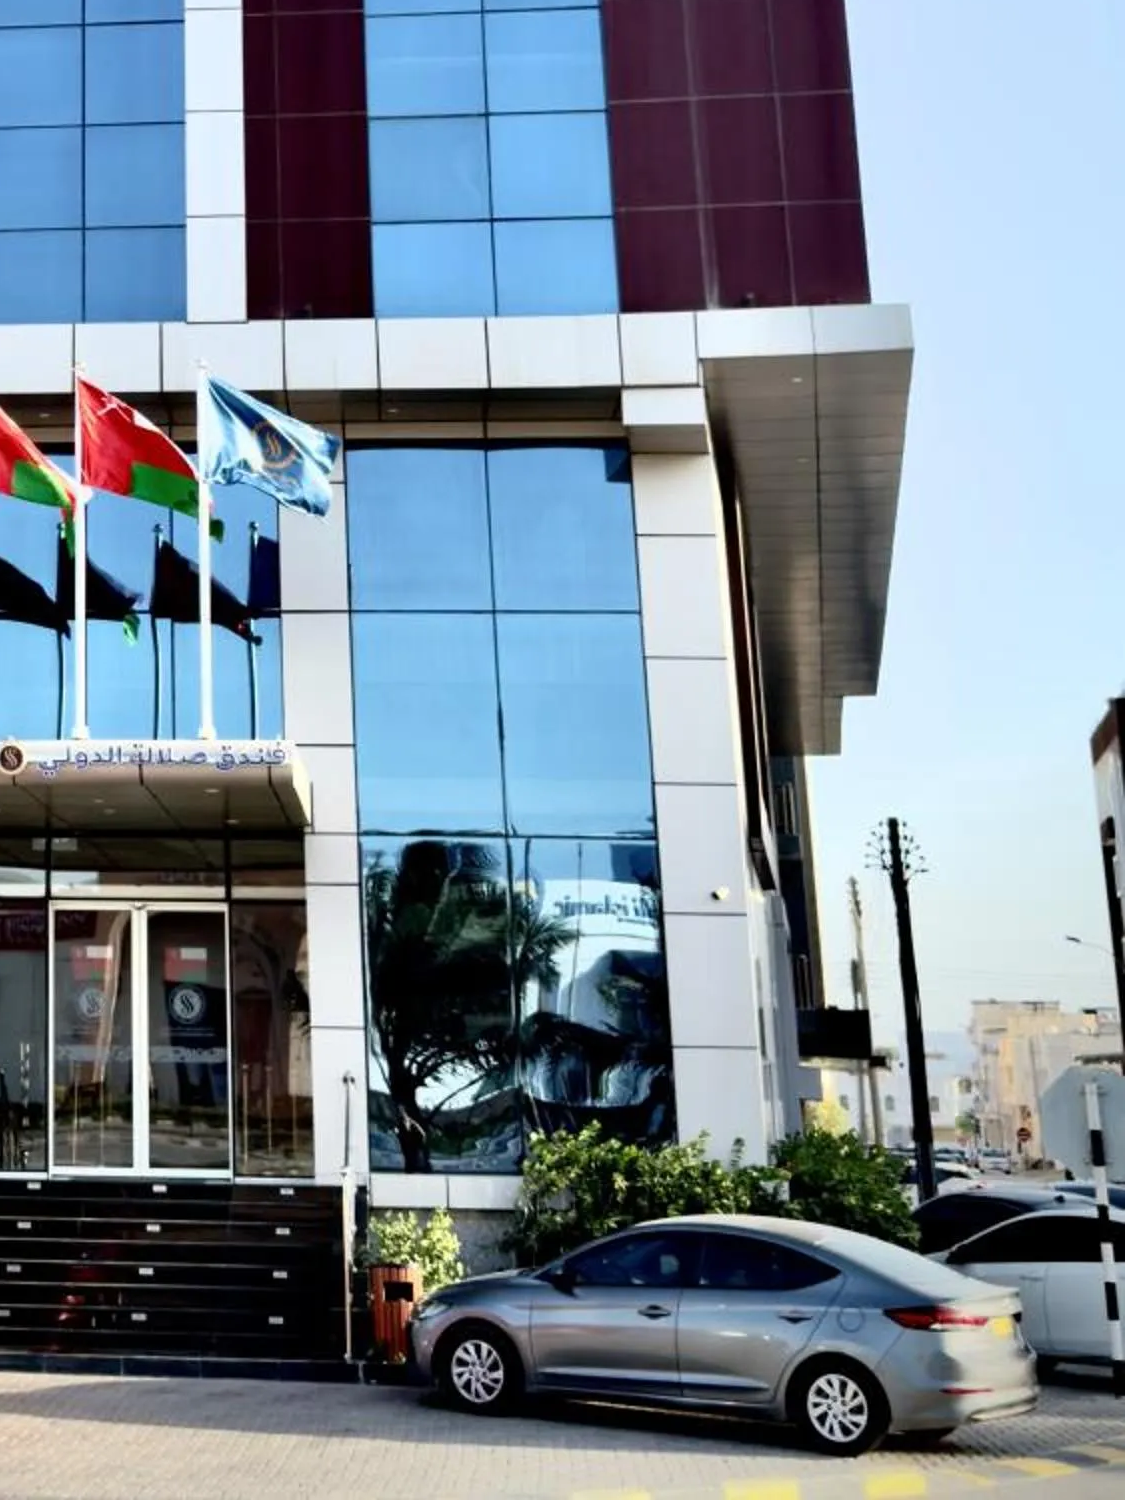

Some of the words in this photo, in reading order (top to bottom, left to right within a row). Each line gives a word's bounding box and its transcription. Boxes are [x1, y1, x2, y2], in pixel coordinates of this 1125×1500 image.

[38, 745, 122, 777] الدولي
[129, 743, 208, 766] صلالة
[215, 742, 287, 771] فندق
